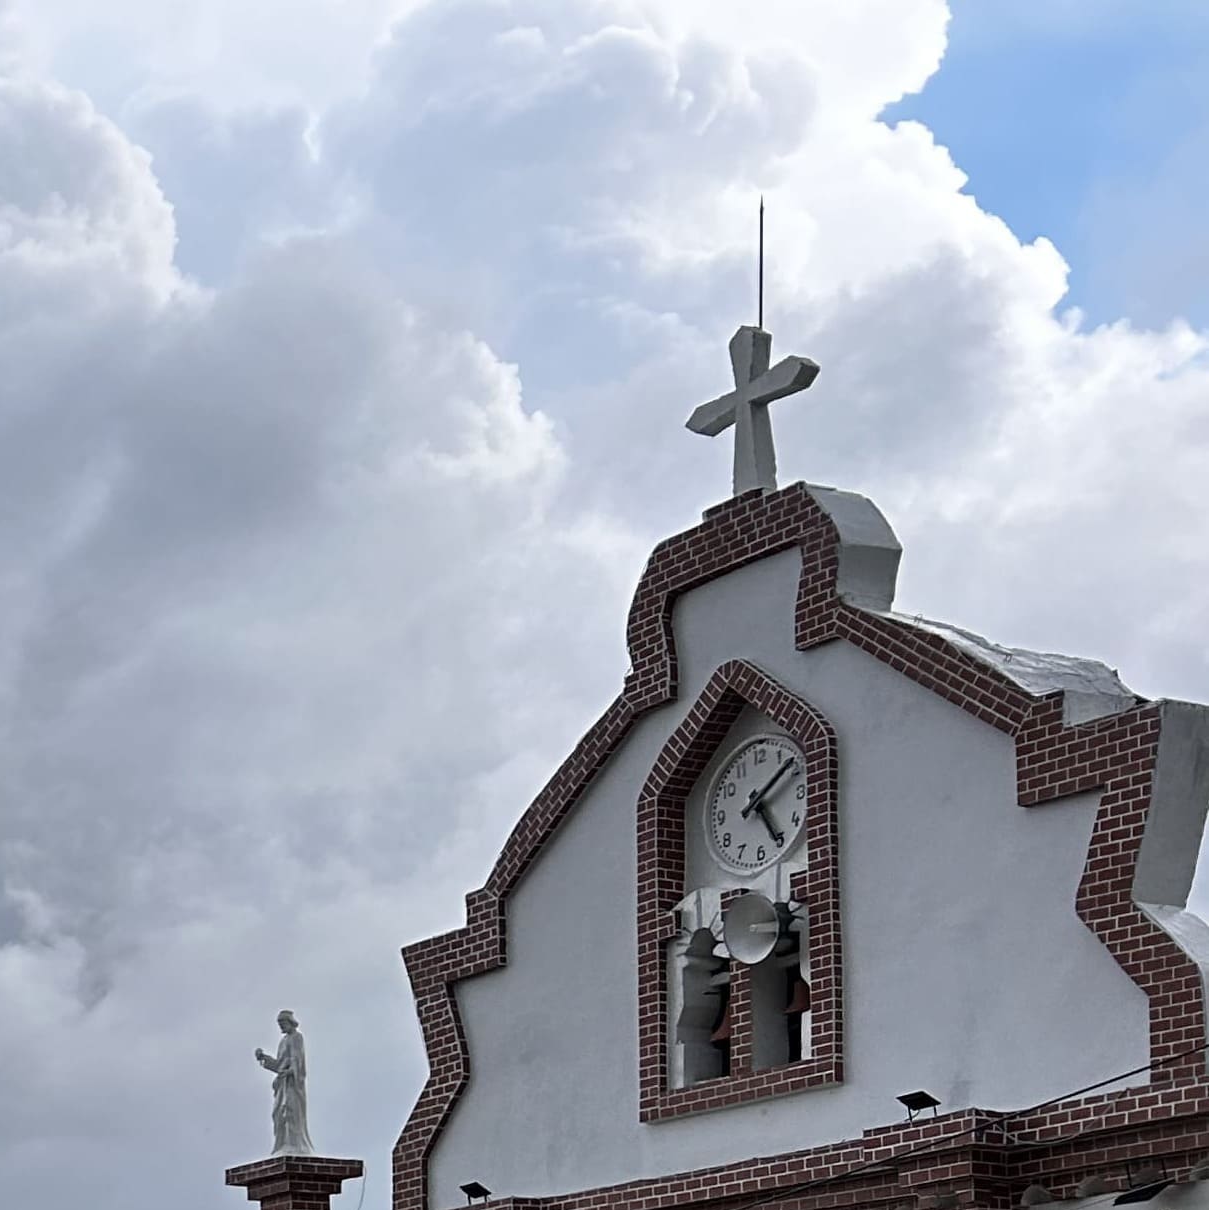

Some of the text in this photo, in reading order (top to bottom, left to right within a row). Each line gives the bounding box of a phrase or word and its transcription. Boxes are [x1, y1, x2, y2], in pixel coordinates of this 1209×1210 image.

[753, 749, 766, 766] 12
[777, 750, 782, 764] 1
[736, 763, 746, 779] 11
[791, 761, 801, 777] 2
[722, 783, 736, 799] 10
[796, 784, 805, 799] 3
[717, 810, 726, 826] 9
[791, 811, 800, 826] 4
[722, 832, 731, 848] 8
[775, 832, 785, 848] 5
[737, 844, 747, 859] 7
[757, 845, 766, 861] 6
